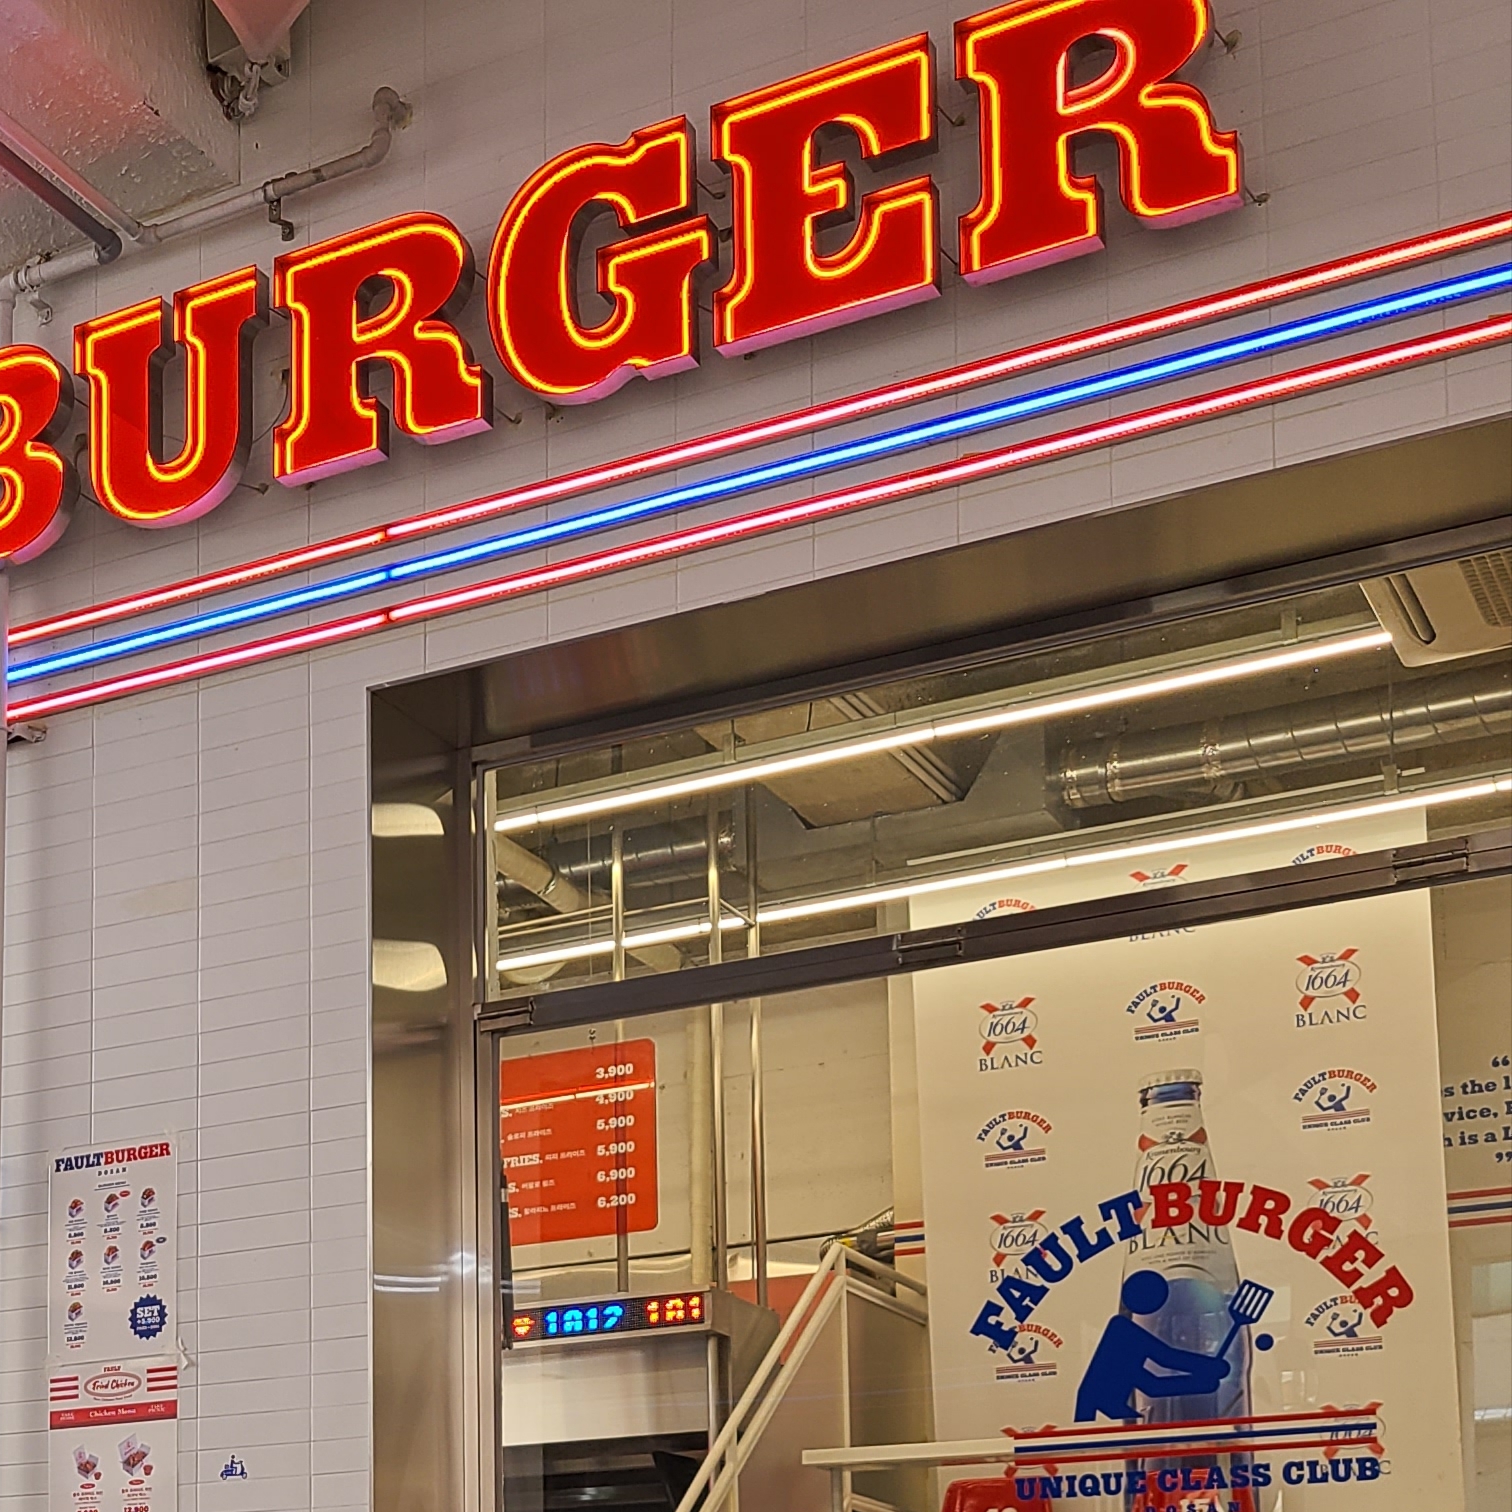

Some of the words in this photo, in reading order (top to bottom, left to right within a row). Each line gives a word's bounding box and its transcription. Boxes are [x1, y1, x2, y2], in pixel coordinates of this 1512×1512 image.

[1305, 969, 1353, 991] 1664
[1126, 981, 1206, 1015] FAULTBURGER
[987, 1016, 1031, 1037] 1664
[1295, 1004, 1367, 1028] BLANC
[596, 1063, 634, 1079] 3,900
[978, 1051, 1043, 1072] BLANC
[1293, 1069, 1378, 1103] FAULTBURGER
[1461, 1079, 1498, 1095] the
[596, 1090, 634, 1105] 4,900
[596, 1115, 635, 1131] 5,900
[977, 1111, 1053, 1143] FAULTBURGER
[1458, 1131, 1480, 1147] is
[1483, 1129, 1498, 1144] a
[54, 1142, 172, 1173] FAULTBURGER
[597, 1141, 635, 1157] 5,900
[597, 1167, 635, 1182] 6,900
[1140, 1154, 1209, 1193] 1664
[597, 1193, 636, 1208] 6,200
[997, 1229, 1039, 1250] 1664
[969, 1179, 1415, 1352] FAULTBURGER
[136, 1305, 161, 1319] SET
[1015, 1470, 1147, 1501] UNIQUE
[1157, 1462, 1272, 1492] CLASS
[1282, 1456, 1382, 1486] CLUB
